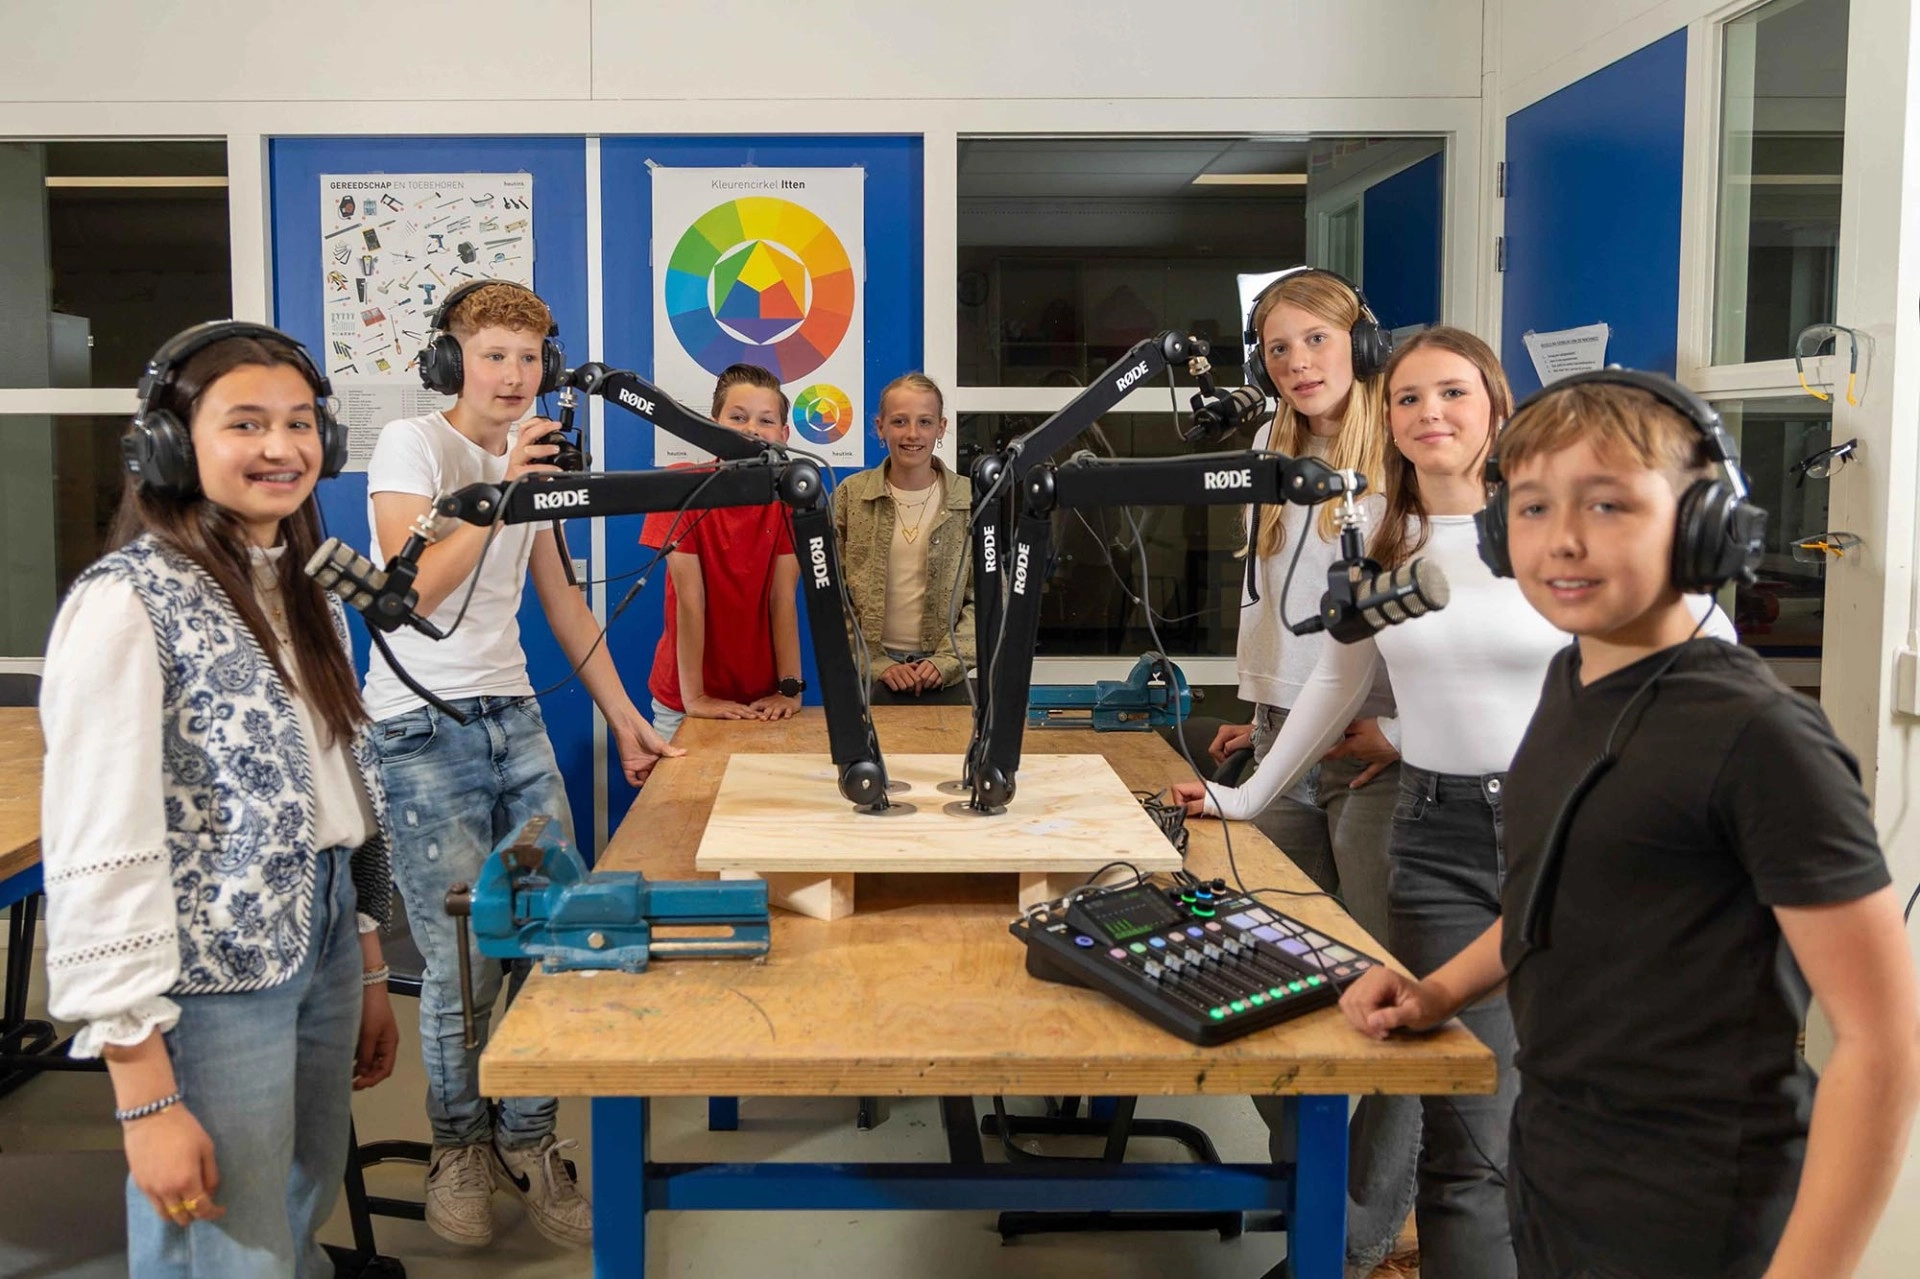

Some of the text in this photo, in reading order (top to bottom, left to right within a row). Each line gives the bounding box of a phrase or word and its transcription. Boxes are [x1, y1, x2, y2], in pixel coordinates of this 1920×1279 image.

[330, 181, 464, 190] GEREEDSCHAP EN TOEBEHOREN
[711, 180, 805, 189] Kleurencirkel Itten
[1115, 360, 1149, 392] RØDE
[618, 387, 656, 416] RØDE
[1203, 468, 1252, 490] RØDE
[533, 488, 590, 510] RØDE
[809, 536, 830, 590] RØDE
[983, 524, 997, 573] RØDE
[1013, 542, 1030, 595] RØDE
